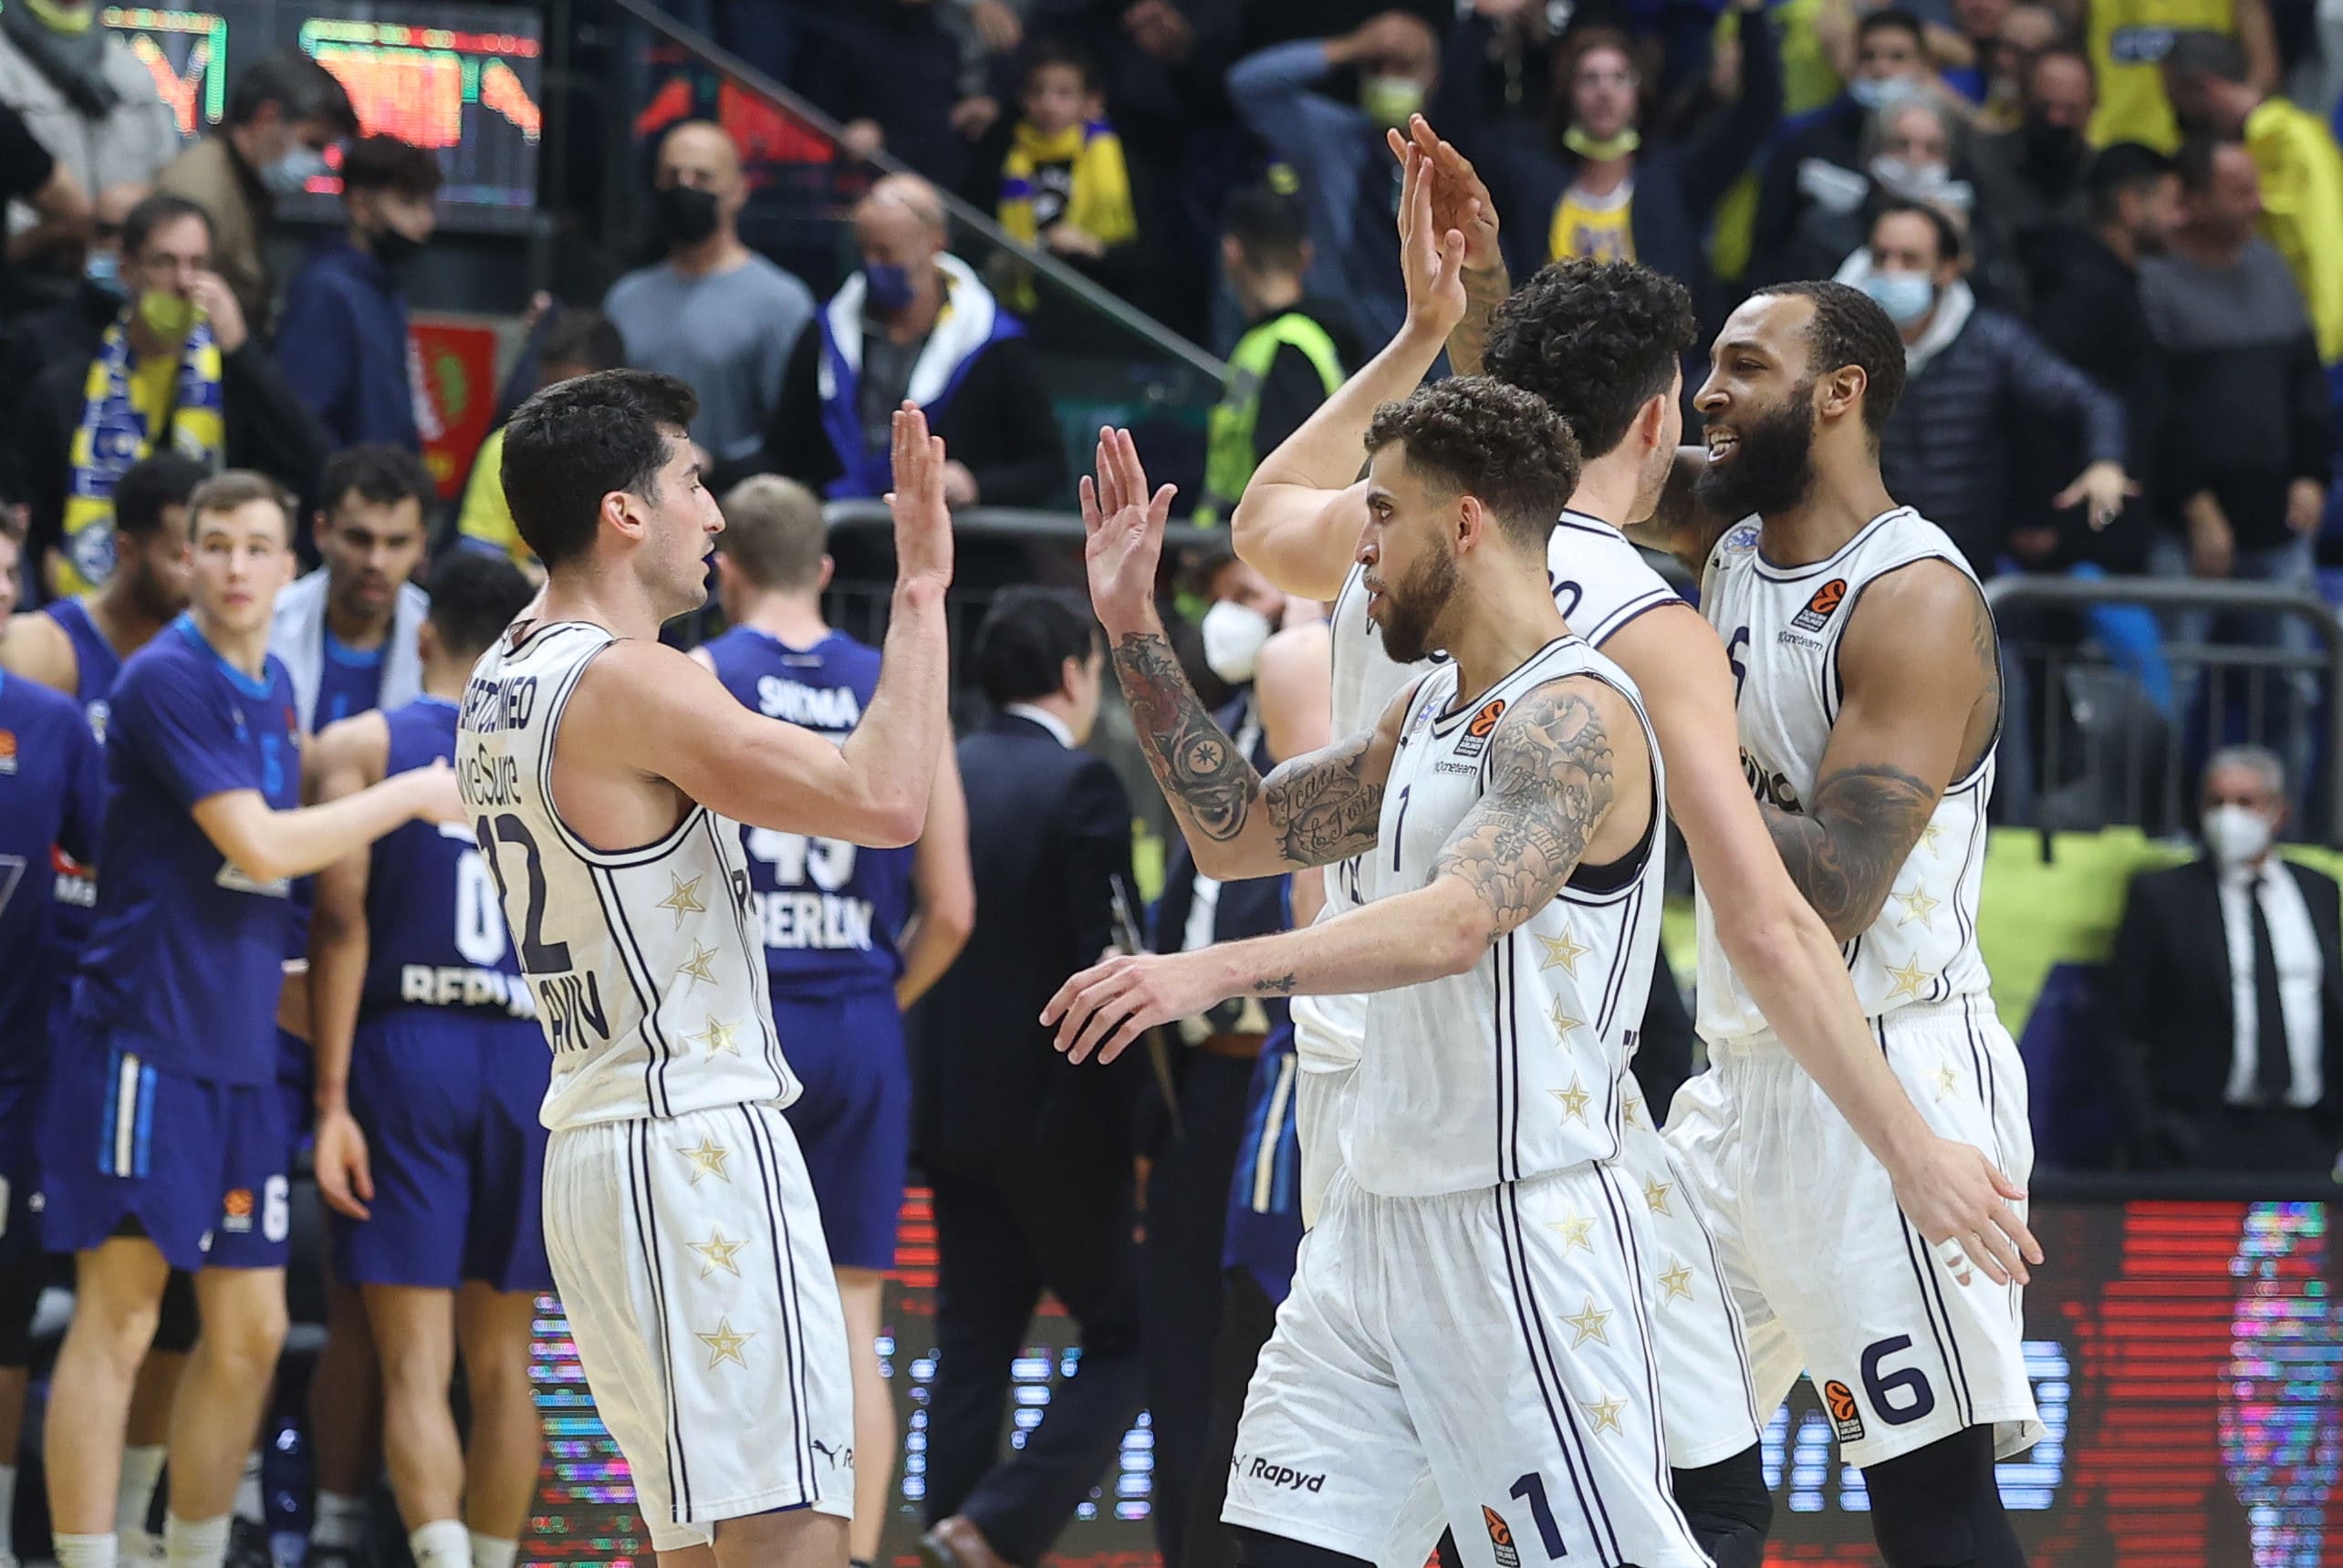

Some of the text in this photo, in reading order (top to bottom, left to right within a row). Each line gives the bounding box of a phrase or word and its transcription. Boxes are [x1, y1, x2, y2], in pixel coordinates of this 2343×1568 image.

[1393, 783, 1411, 872] 1
[455, 846, 506, 967] 0
[476, 814, 574, 975] 12
[263, 1174, 289, 1242] 6
[1860, 1334, 1935, 1426] 6
[1249, 1457, 1327, 1493] Rapyd
[1509, 1471, 1567, 1561] 1
